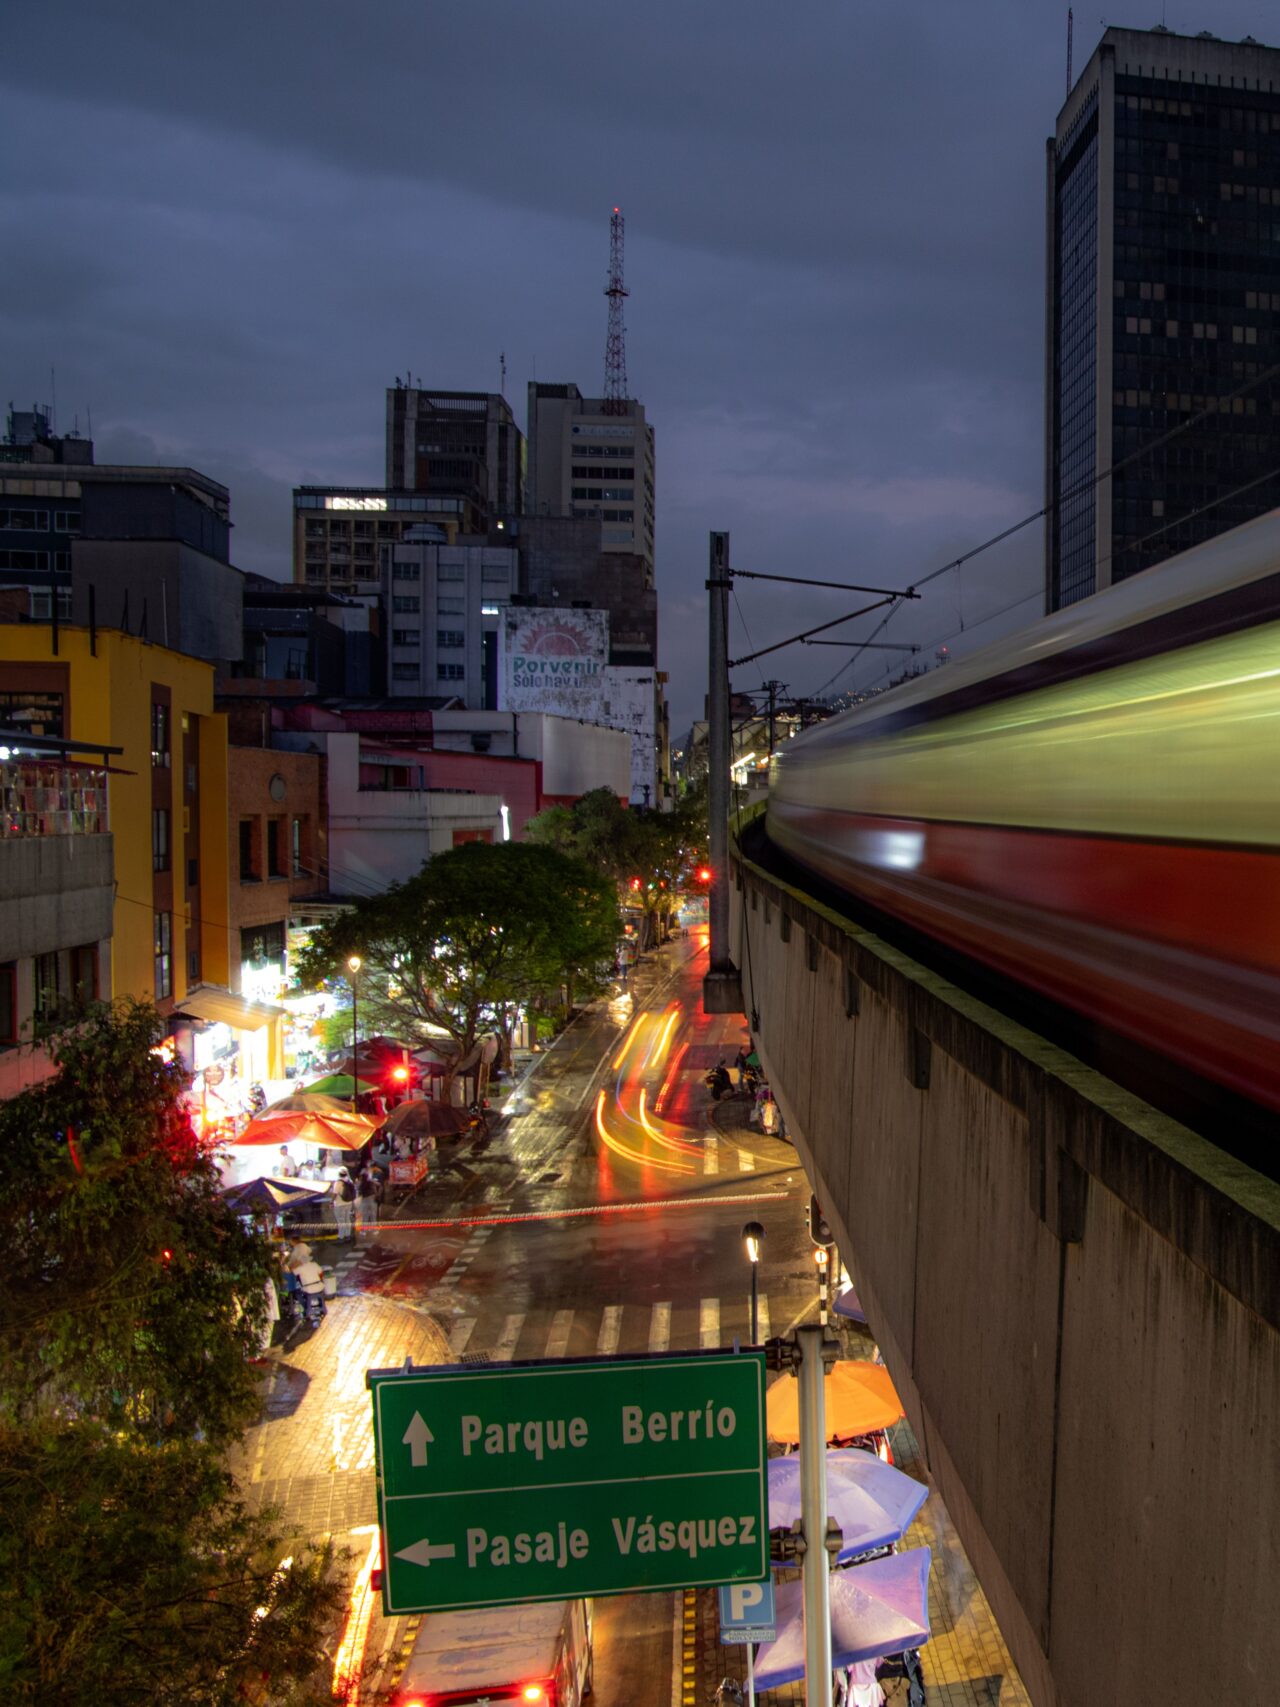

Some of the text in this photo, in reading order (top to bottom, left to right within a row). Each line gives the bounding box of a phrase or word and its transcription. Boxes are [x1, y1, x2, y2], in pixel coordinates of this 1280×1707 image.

[513, 657, 600, 674] Porvenir
[544, 674, 571, 688] hay
[462, 1400, 736, 1460] Parque Berrío
[467, 1515, 756, 1568] Pasaje Vásquez
[730, 1583, 763, 1620] P
